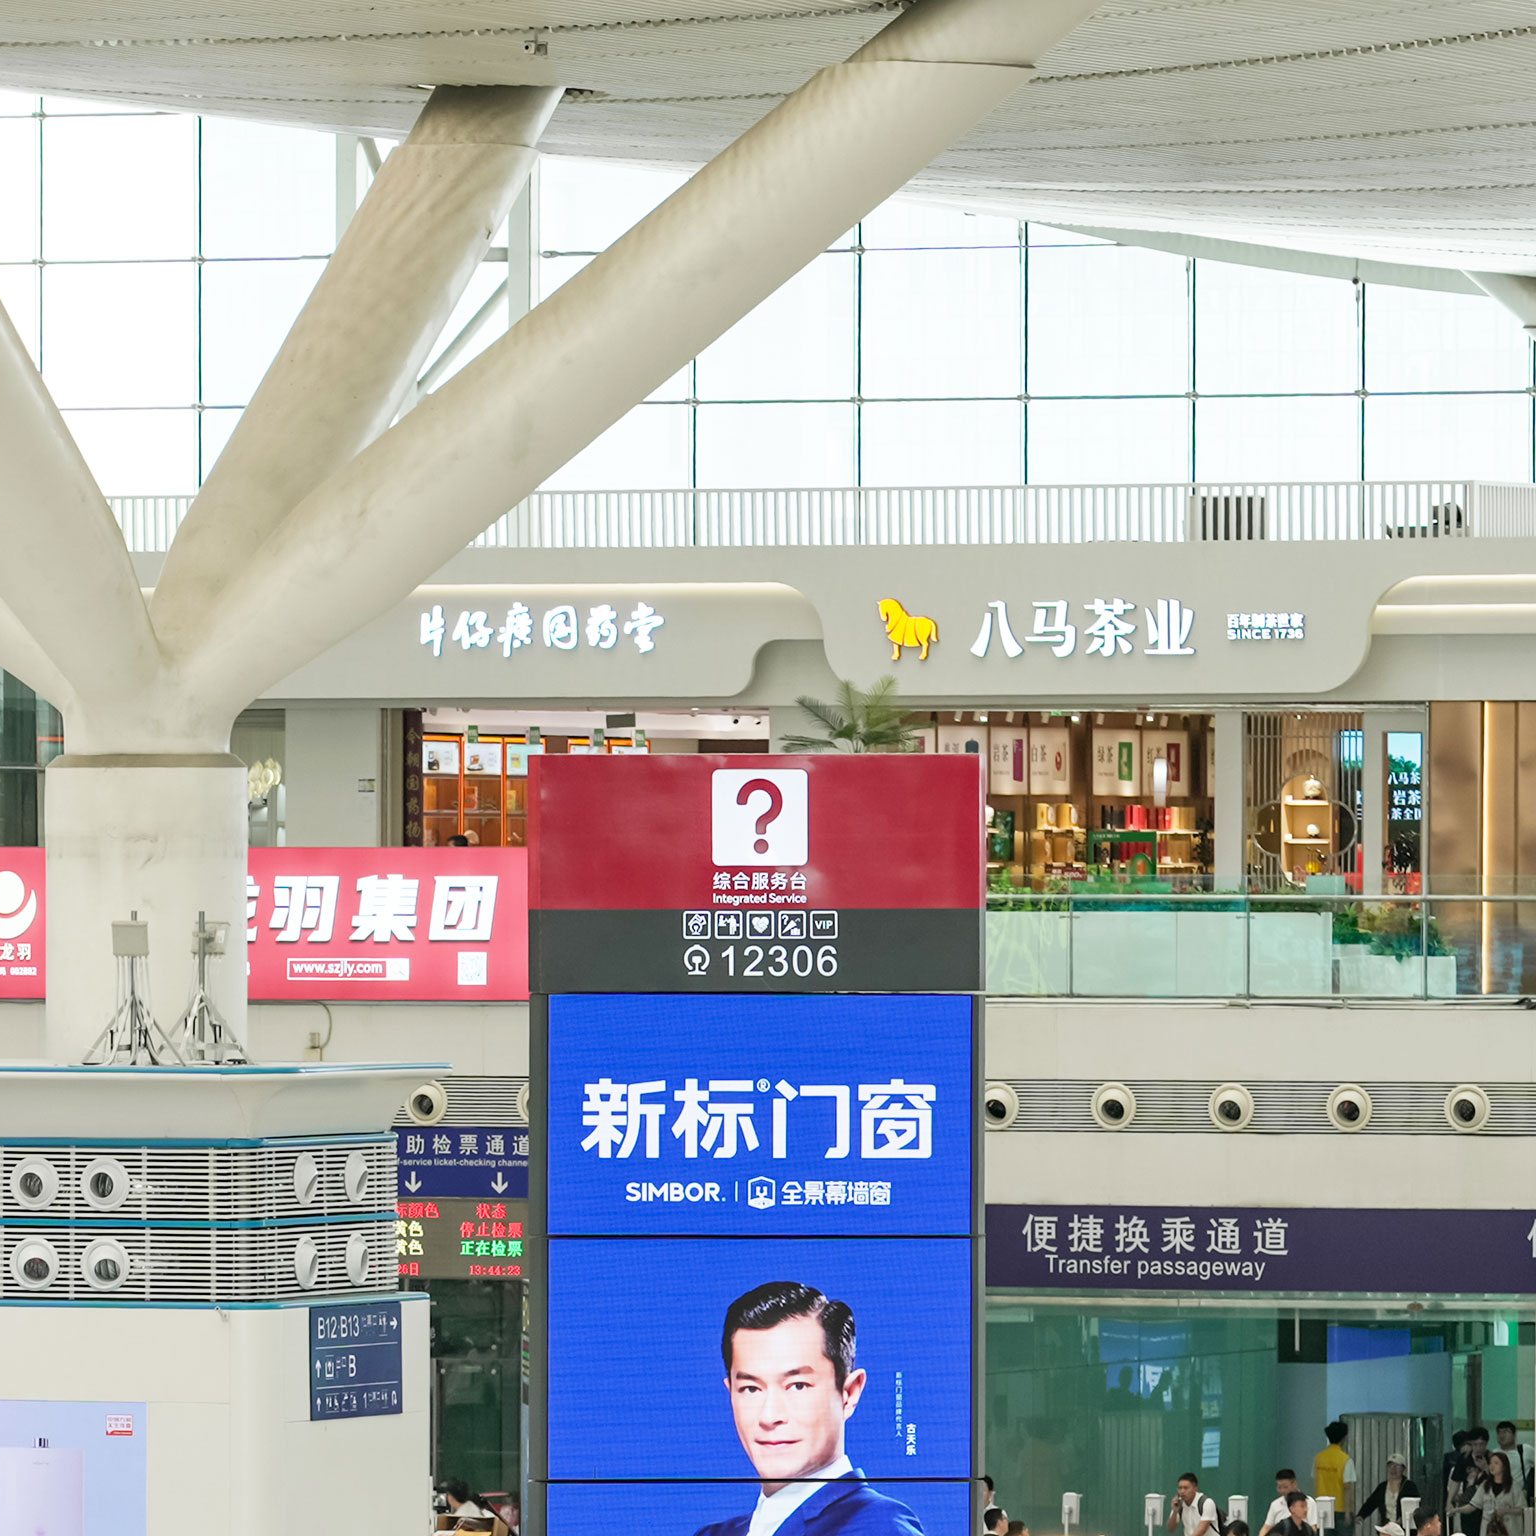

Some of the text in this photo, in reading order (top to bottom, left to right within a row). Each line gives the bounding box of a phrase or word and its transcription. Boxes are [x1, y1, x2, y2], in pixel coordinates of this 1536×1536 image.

[971, 599, 1196, 658] 八马茶业
[1227, 629, 1305, 640] SINCE 1736
[712, 872, 808, 891] 综合服务台
[712, 893, 807, 906] Integrated Service
[815, 920, 834, 930] VIP
[292, 961, 383, 977] www.szjly.com
[721, 945, 838, 977] 12306
[434, 1158, 495, 1167] ticket-checking
[781, 1181, 892, 1206] 全景幕墙窗
[476, 1203, 507, 1219] 状态
[459, 1222, 523, 1238] 停止检票
[1022, 1213, 1290, 1257] 便捷换乘通道
[459, 1240, 523, 1257] 正在检票
[469, 1264, 522, 1276] 13:44:23
[1044, 1254, 1131, 1277] Transfer
[1136, 1256, 1266, 1281] passageway
[905, 1423, 917, 1456] 古天乐
